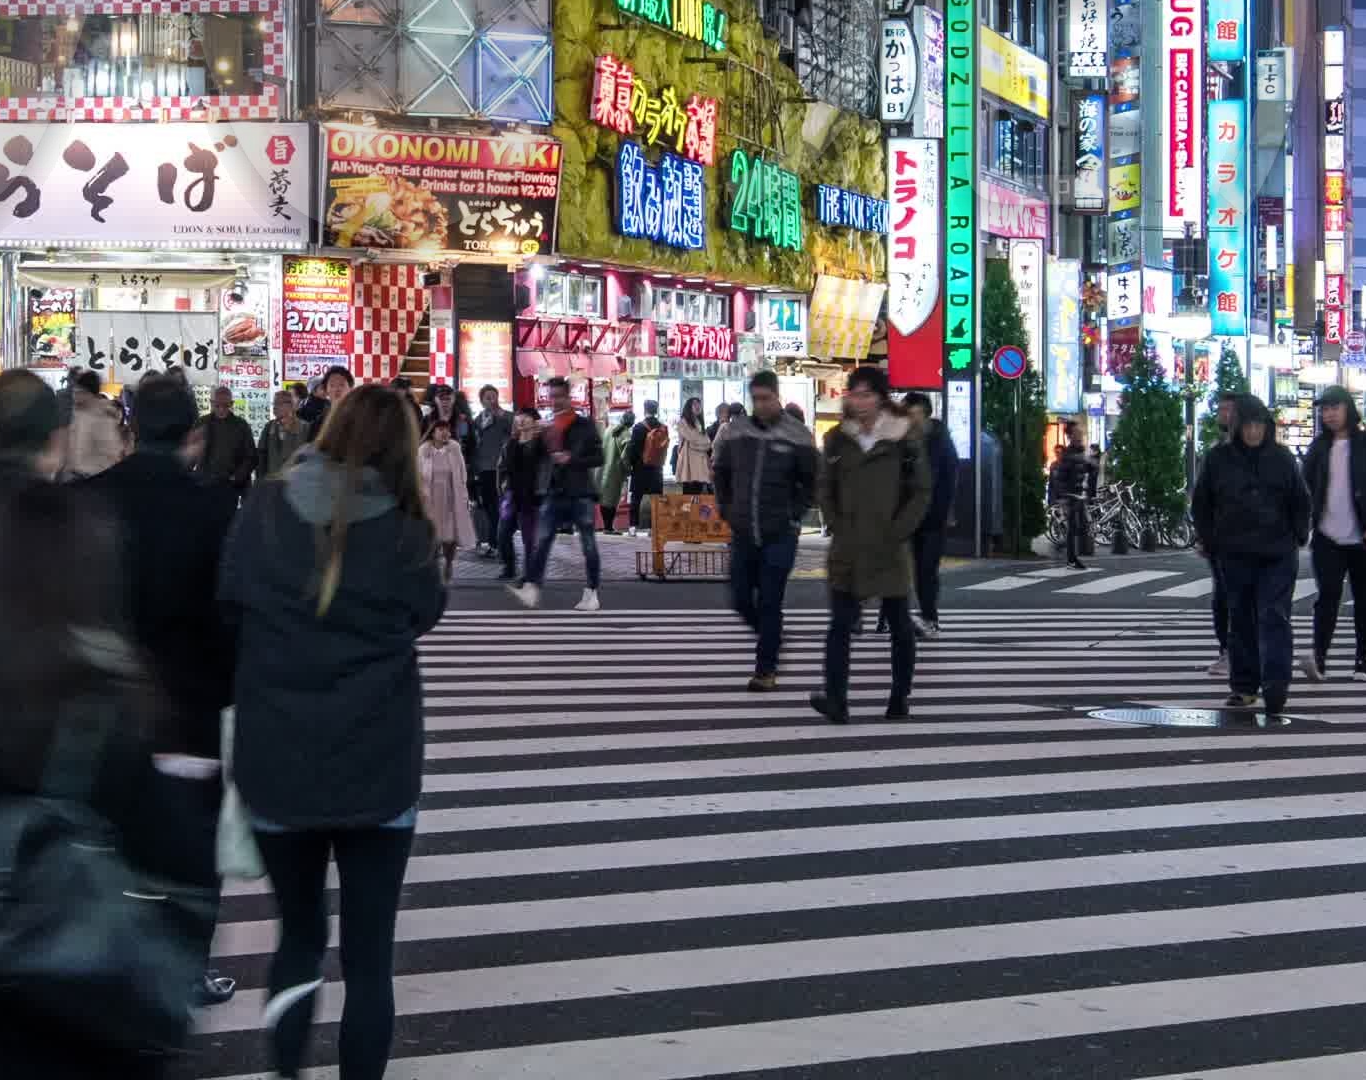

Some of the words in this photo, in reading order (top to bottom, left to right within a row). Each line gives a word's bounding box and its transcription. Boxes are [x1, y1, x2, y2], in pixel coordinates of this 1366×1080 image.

[886, 0, 904, 14] 1F
[884, 27, 907, 38] 新宿
[886, 102, 905, 114] B1
[330, 130, 479, 164] OKONOMI
[489, 139, 559, 170] YAKI
[331, 160, 421, 177] All-You-Can-Eat
[422, 167, 460, 179] dinner
[460, 169, 484, 181] with
[487, 171, 557, 185] Free-Flowing
[420, 180, 457, 192] Drinks
[459, 182, 475, 193] for
[476, 183, 484, 194] 2
[486, 184, 518, 196] hours
[521, 186, 556, 198] ¥2,700
[620, 142, 704, 250] 飲み放題
[731, 148, 802, 252] 24時間
[818, 185, 841, 223] THE
[893, 150, 918, 260] トラノコ
[1215, 121, 1238, 313] カラオケ館
[214, 224, 243, 237] SOBA
[522, 242, 538, 254] 2F
[950, 214, 970, 308] ROAD
[765, 339, 804, 354] 虎の子
